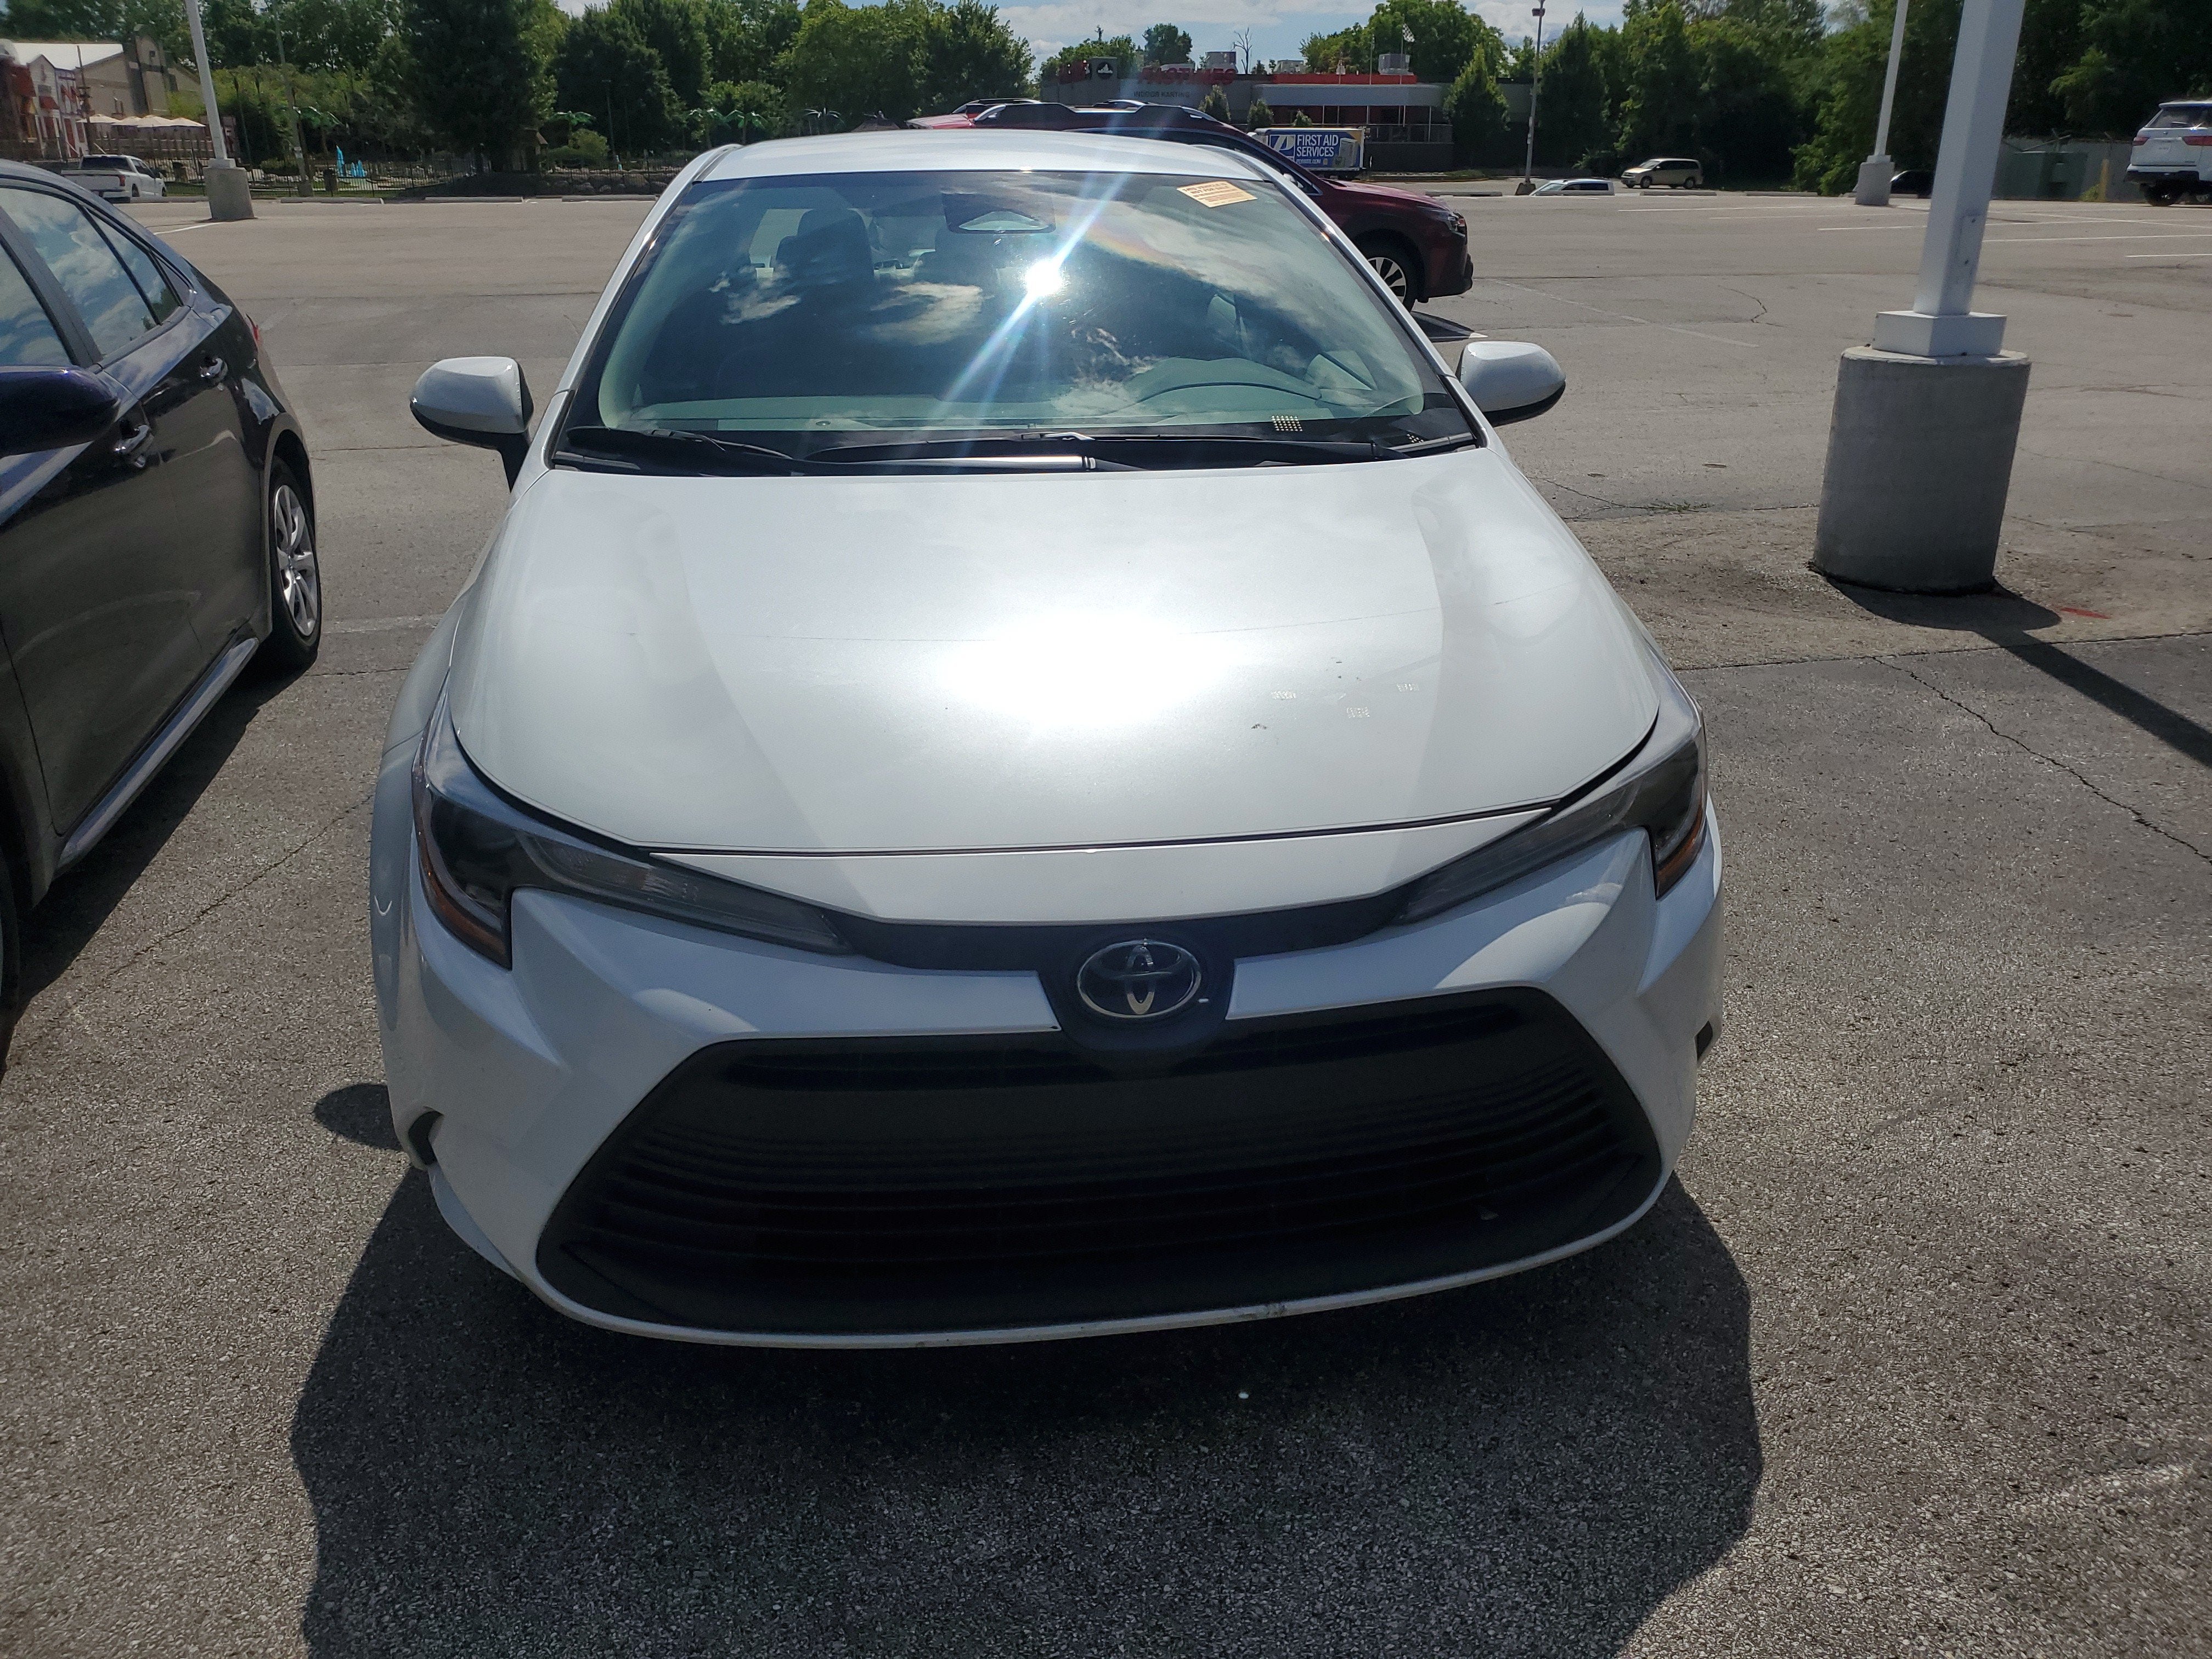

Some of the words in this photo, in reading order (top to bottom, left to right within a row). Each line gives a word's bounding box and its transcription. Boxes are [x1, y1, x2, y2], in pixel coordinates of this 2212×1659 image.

[1297, 134, 1322, 146] FIRST
[1323, 134, 1339, 146] AID
[1296, 146, 1334, 157] SERVICES
